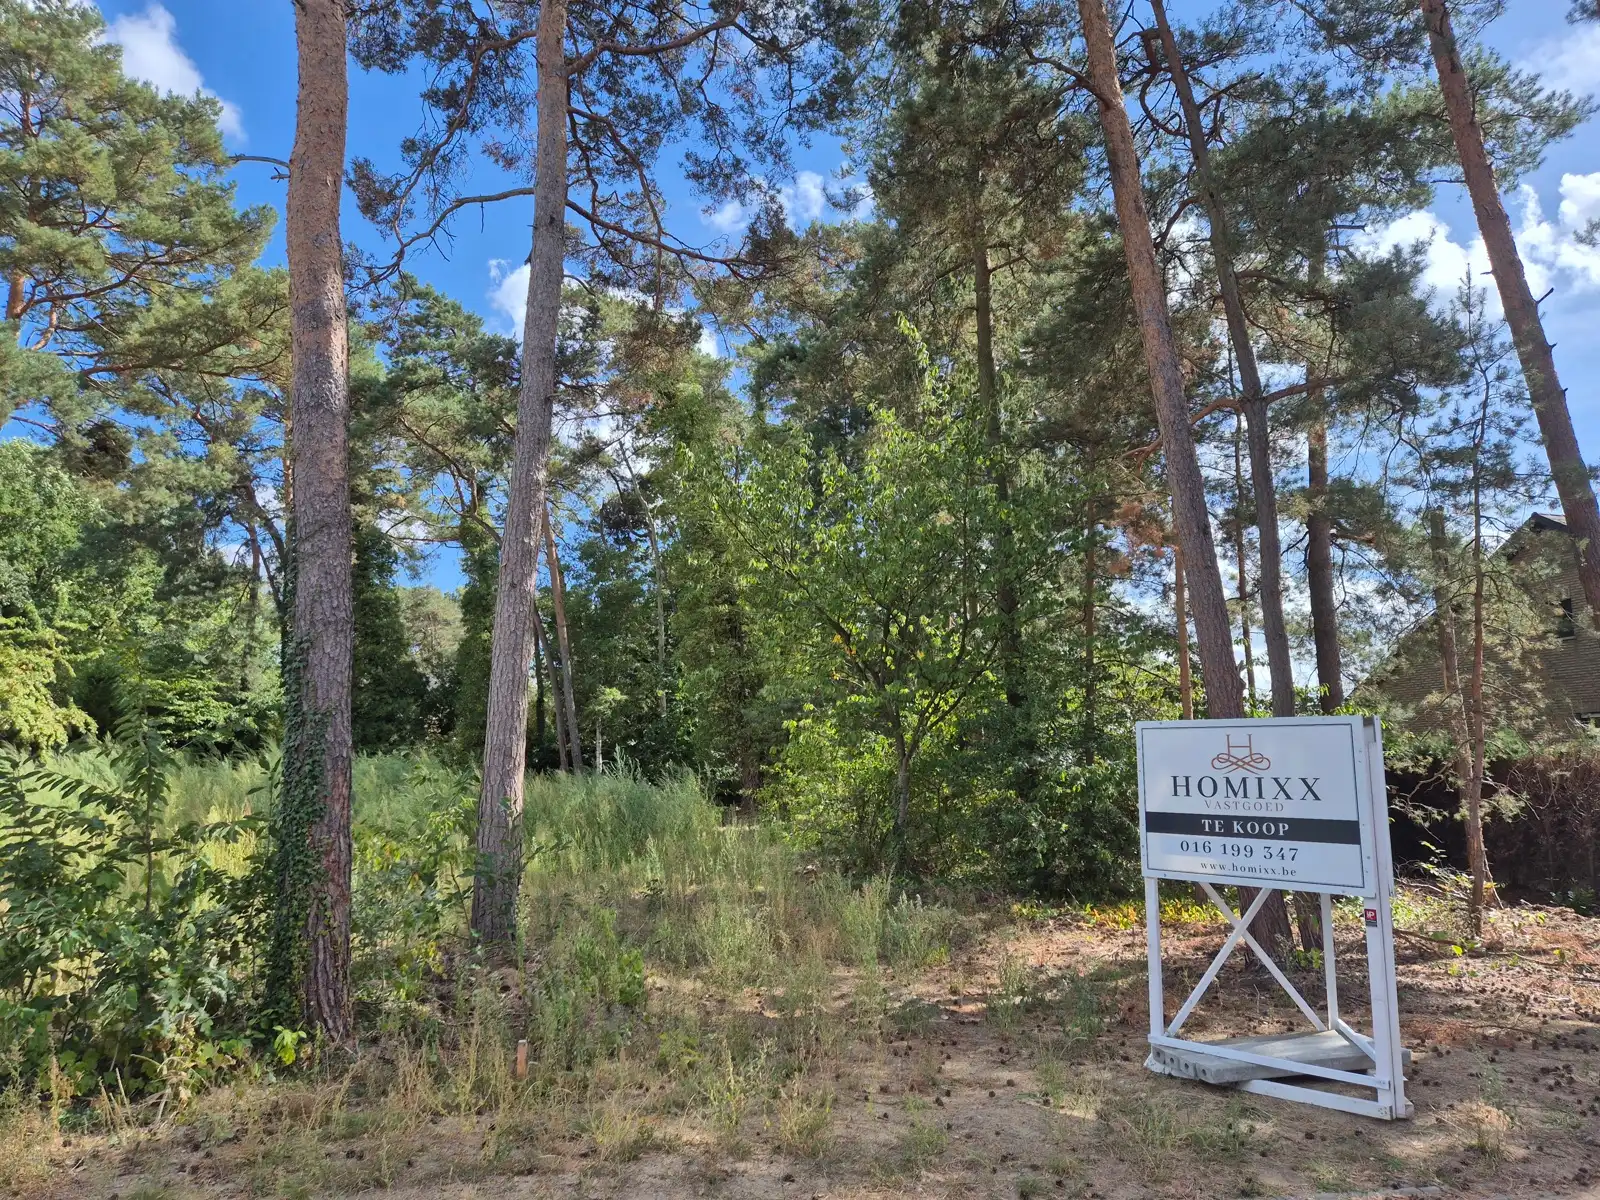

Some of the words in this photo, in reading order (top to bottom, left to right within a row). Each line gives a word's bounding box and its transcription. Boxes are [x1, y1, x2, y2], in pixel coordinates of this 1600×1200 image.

[1171, 775, 1322, 801] HOMIXX
[1204, 800, 1284, 812] VASTGOED
[1201, 819, 1224, 833] TE
[1232, 821, 1289, 836] KOOP
[1180, 840, 1212, 854] 016
[1221, 843, 1254, 858] 199
[1263, 846, 1299, 862] 347
[1200, 862, 1297, 877] www.homixx.be
